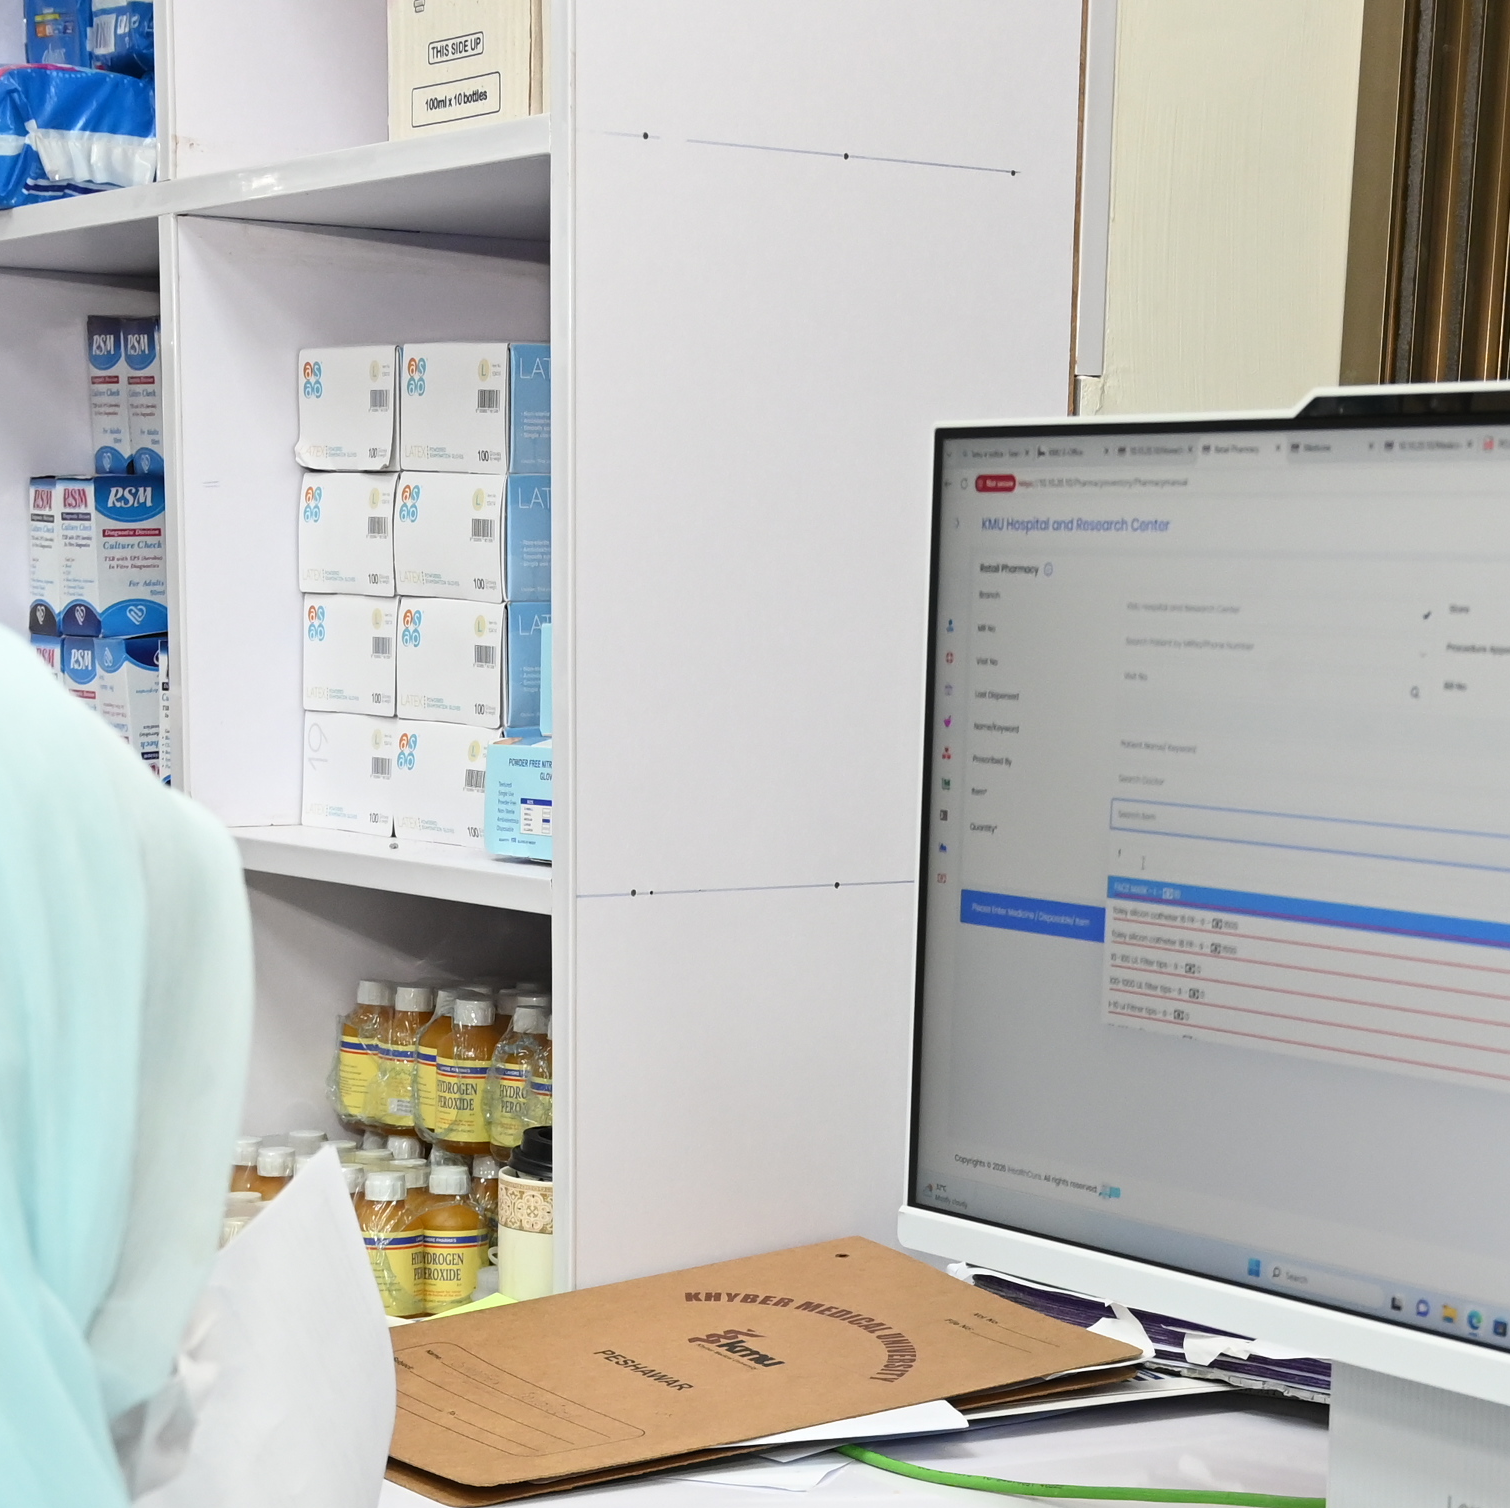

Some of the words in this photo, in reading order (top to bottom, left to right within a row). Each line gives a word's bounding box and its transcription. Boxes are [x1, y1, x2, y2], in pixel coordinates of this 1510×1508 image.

[431, 44, 450, 59] THIS
[451, 40, 469, 54] SIDE
[470, 37, 481, 50] UP
[425, 96, 447, 111] 100ml
[454, 95, 463, 105] 10
[463, 89, 488, 104] bottles
[93, 334, 115, 355] RSM
[127, 334, 149, 355] RSM
[519, 357, 551, 380] LAT
[477, 450, 489, 462] 100
[33, 489, 53, 511] RSM
[63, 487, 88, 509] RSM
[107, 486, 153, 508] RSM
[518, 487, 551, 509] LAT
[104, 529, 134, 537] Diagnostic
[981, 517, 1004, 532] KMU
[1007, 516, 1049, 535] Hospital
[1052, 518, 1073, 532] and
[1076, 518, 1128, 533] Research
[1131, 518, 1170, 533] Center
[102, 541, 135, 550] Culture
[137, 540, 162, 550] Check
[368, 573, 378, 584] 100
[980, 563, 1000, 574] Retail
[1001, 563, 1039, 577] Pharmacy
[473, 578, 485, 590] 100
[70, 649, 92, 671] RSM
[372, 692, 382, 704] 100
[474, 703, 485, 715] 100
[508, 758, 528, 767] POWDER
[529, 759, 541, 768] FREE
[542, 761, 552, 769] NITR
[369, 812, 379, 824] 100
[955, 1153, 985, 1169] Copyrights
[1052, 1176, 1069, 1187] rights
[945, 1318, 958, 1327] File
[685, 1292, 794, 1307] KHYBER
[794, 1301, 892, 1334] MEDICAL
[870, 1332, 917, 1383] UNIVERSITY
[716, 1340, 785, 1367] kmu
[594, 1350, 693, 1391] PESHAWAR
